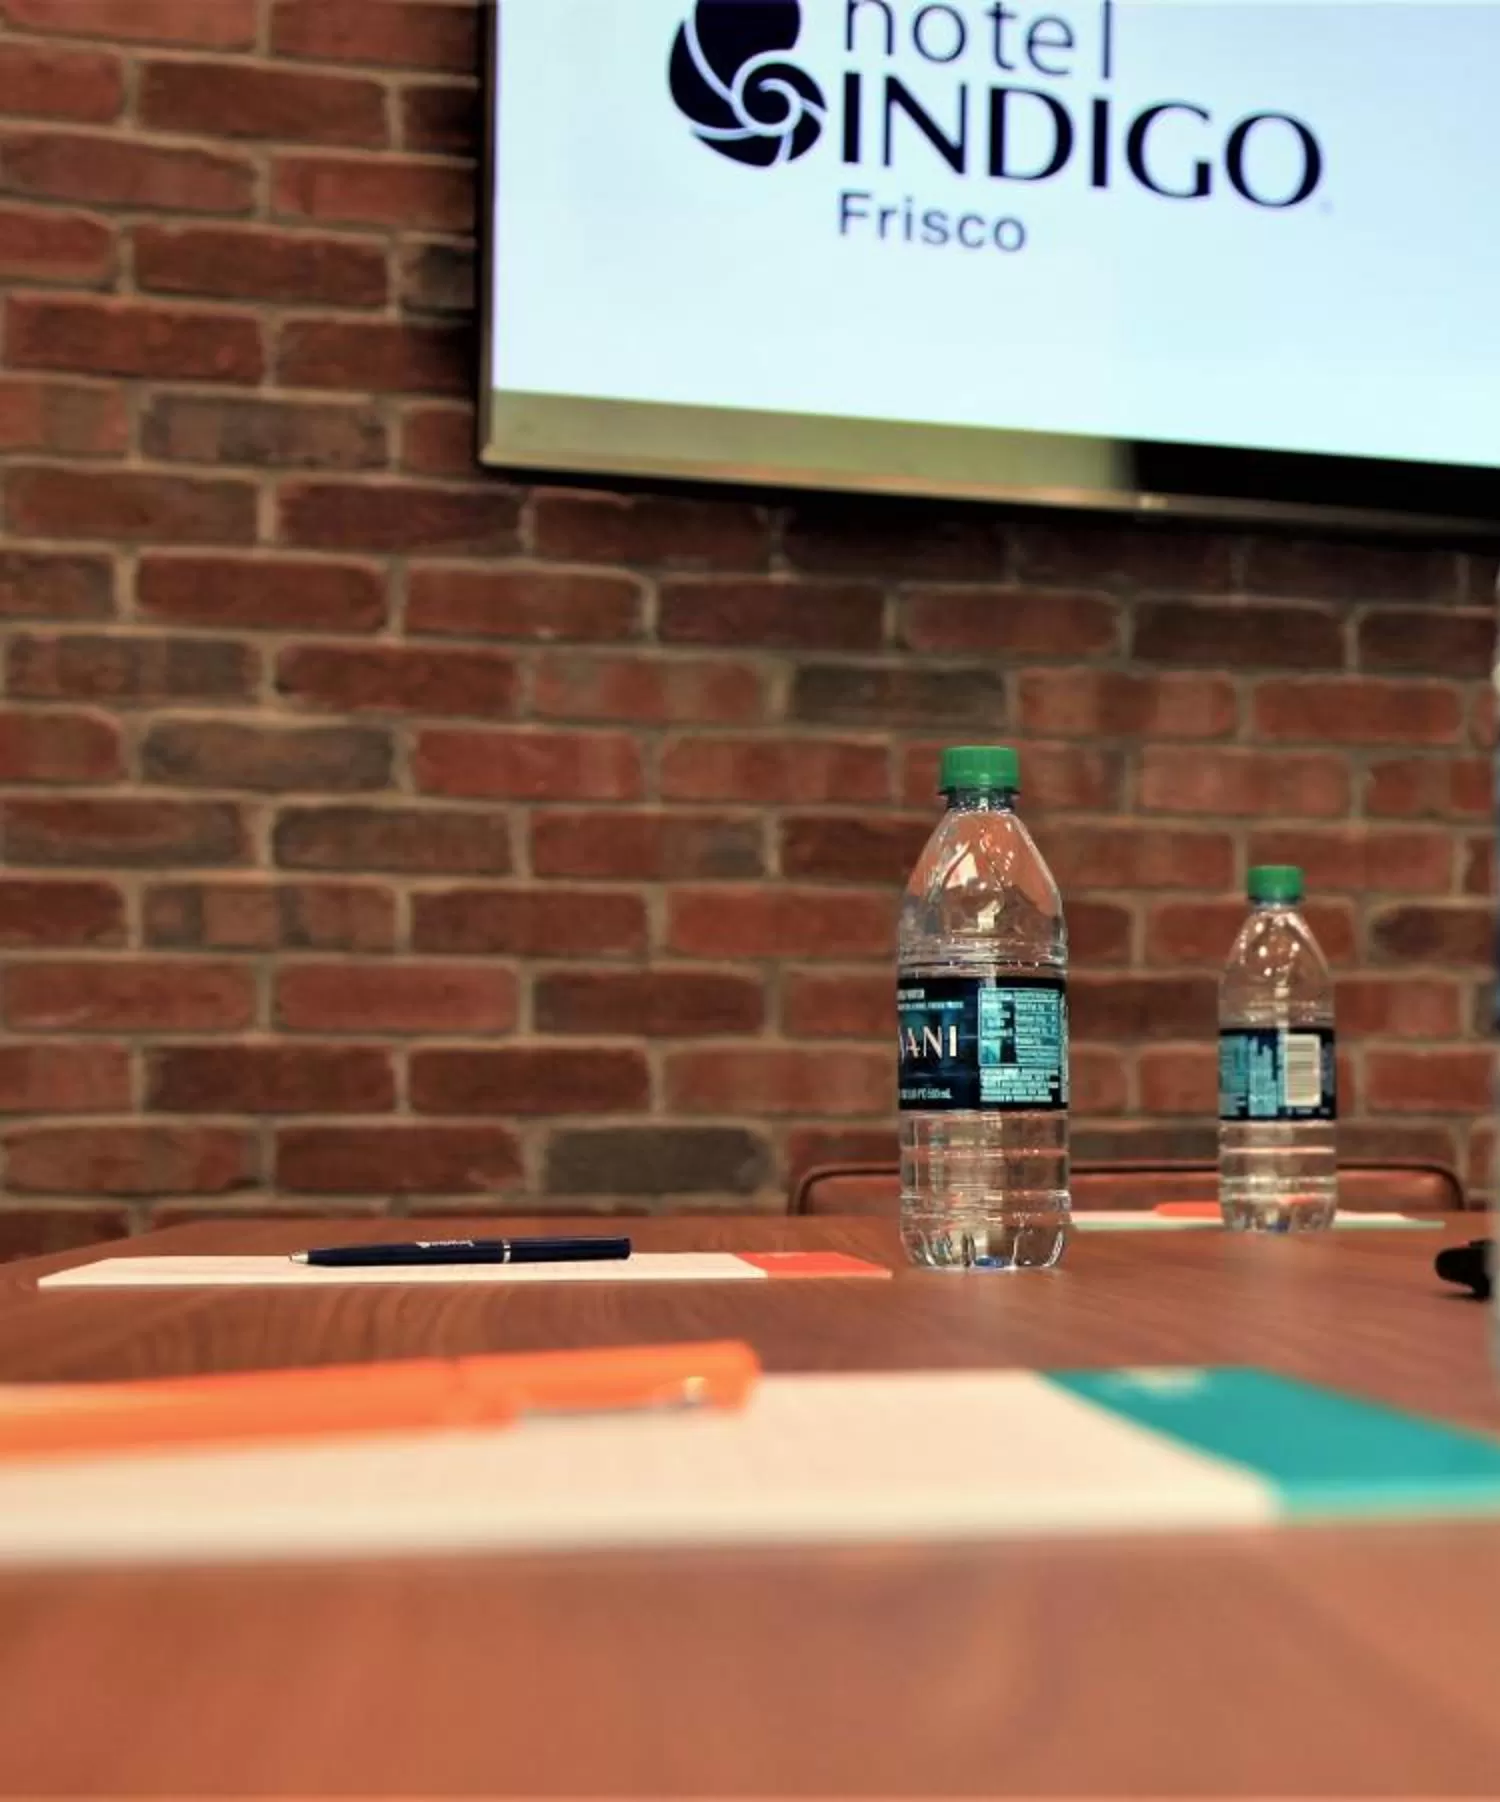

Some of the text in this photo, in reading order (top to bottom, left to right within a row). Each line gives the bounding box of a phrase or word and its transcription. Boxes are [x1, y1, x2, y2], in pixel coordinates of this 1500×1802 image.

[844, 0, 1113, 79] hotel
[842, 71, 1323, 208] INDIGO
[838, 191, 1027, 253] Frisco
